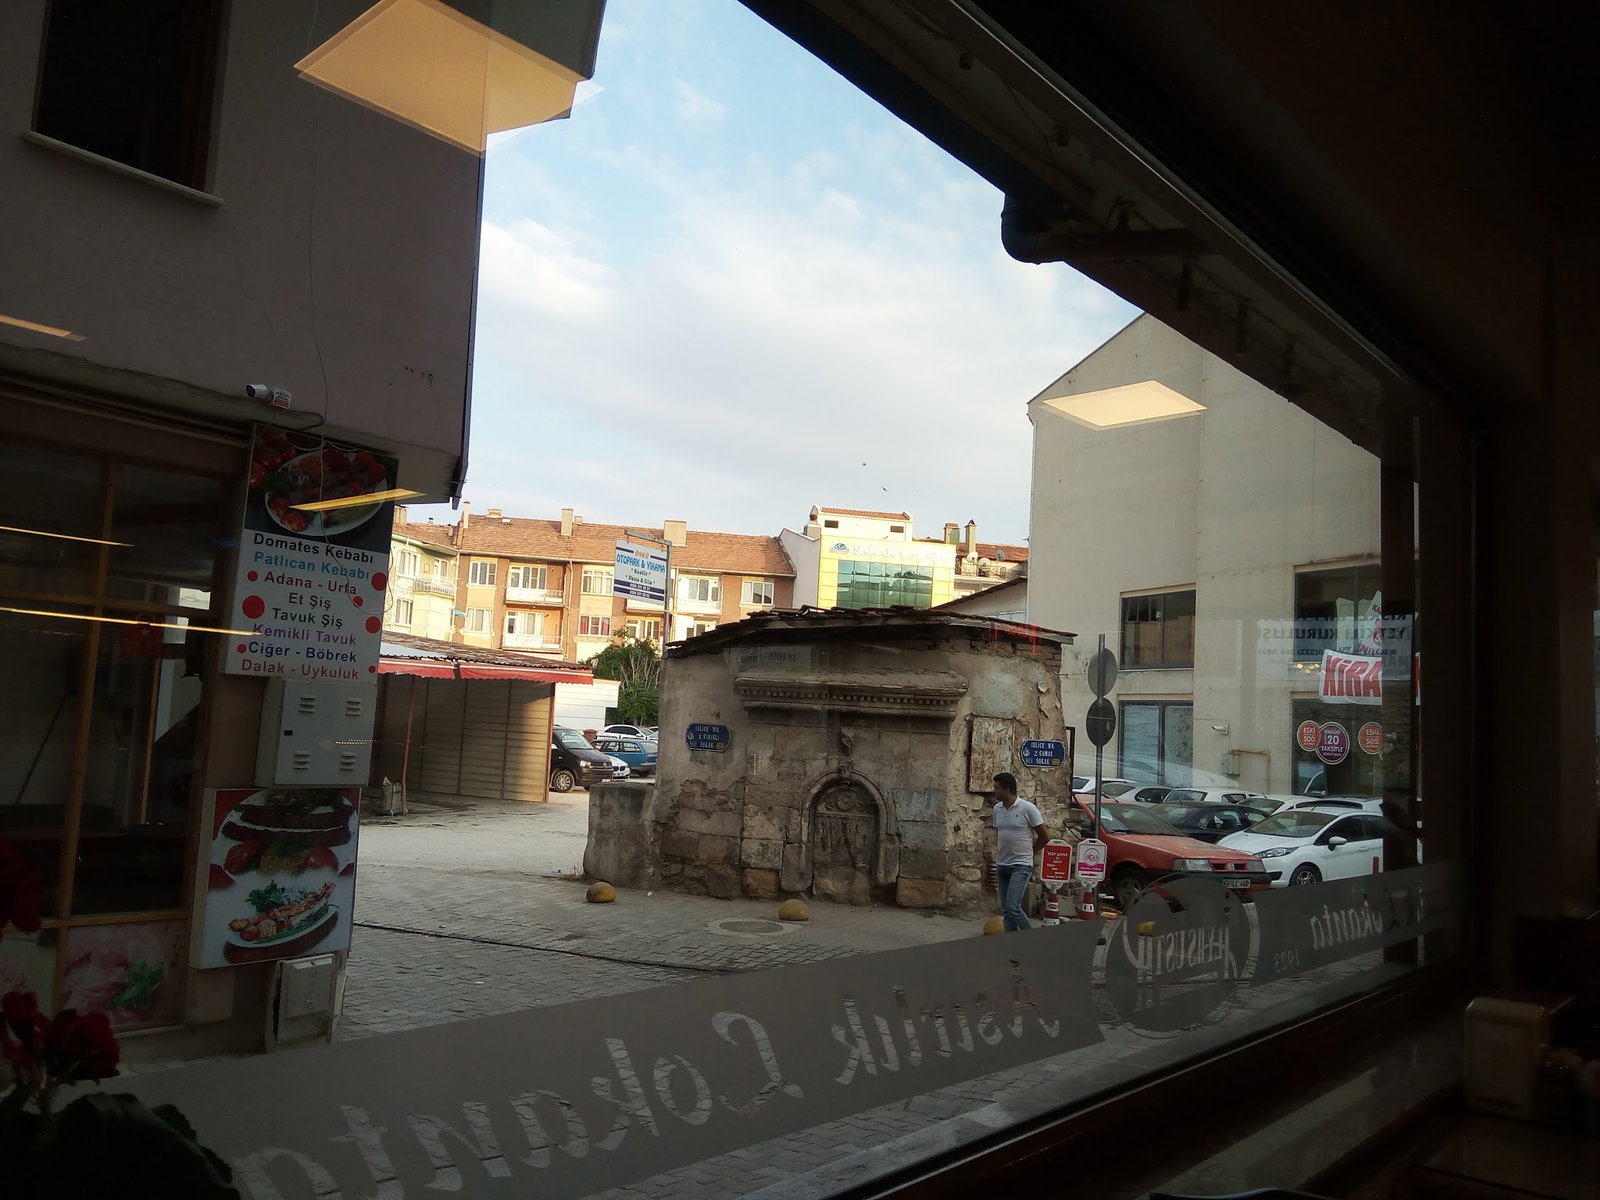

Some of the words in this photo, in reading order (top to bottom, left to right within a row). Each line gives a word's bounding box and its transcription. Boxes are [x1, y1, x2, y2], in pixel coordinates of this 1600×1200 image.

[254, 533, 320, 554] Domates
[325, 545, 374, 564] Kebabı
[254, 551, 315, 572] Patlıcan
[321, 562, 369, 580] Kebabı
[616, 553, 640, 567] OTOPARK
[264, 571, 312, 589] Adana
[328, 580, 357, 595] Urfa
[288, 592, 304, 605] Et
[309, 595, 331, 611] Şiş
[272, 607, 316, 624] Tavuk
[321, 614, 343, 629] Şiş
[253, 623, 310, 641] Kemikli
[315, 630, 357, 646] Tavuk
[248, 641, 290, 658] Ciğer
[306, 647, 357, 663] Böbrek
[242, 659, 285, 674] Dalak
[301, 664, 359, 680] Uykuluk
[1327, 735, 1340, 745] 20
